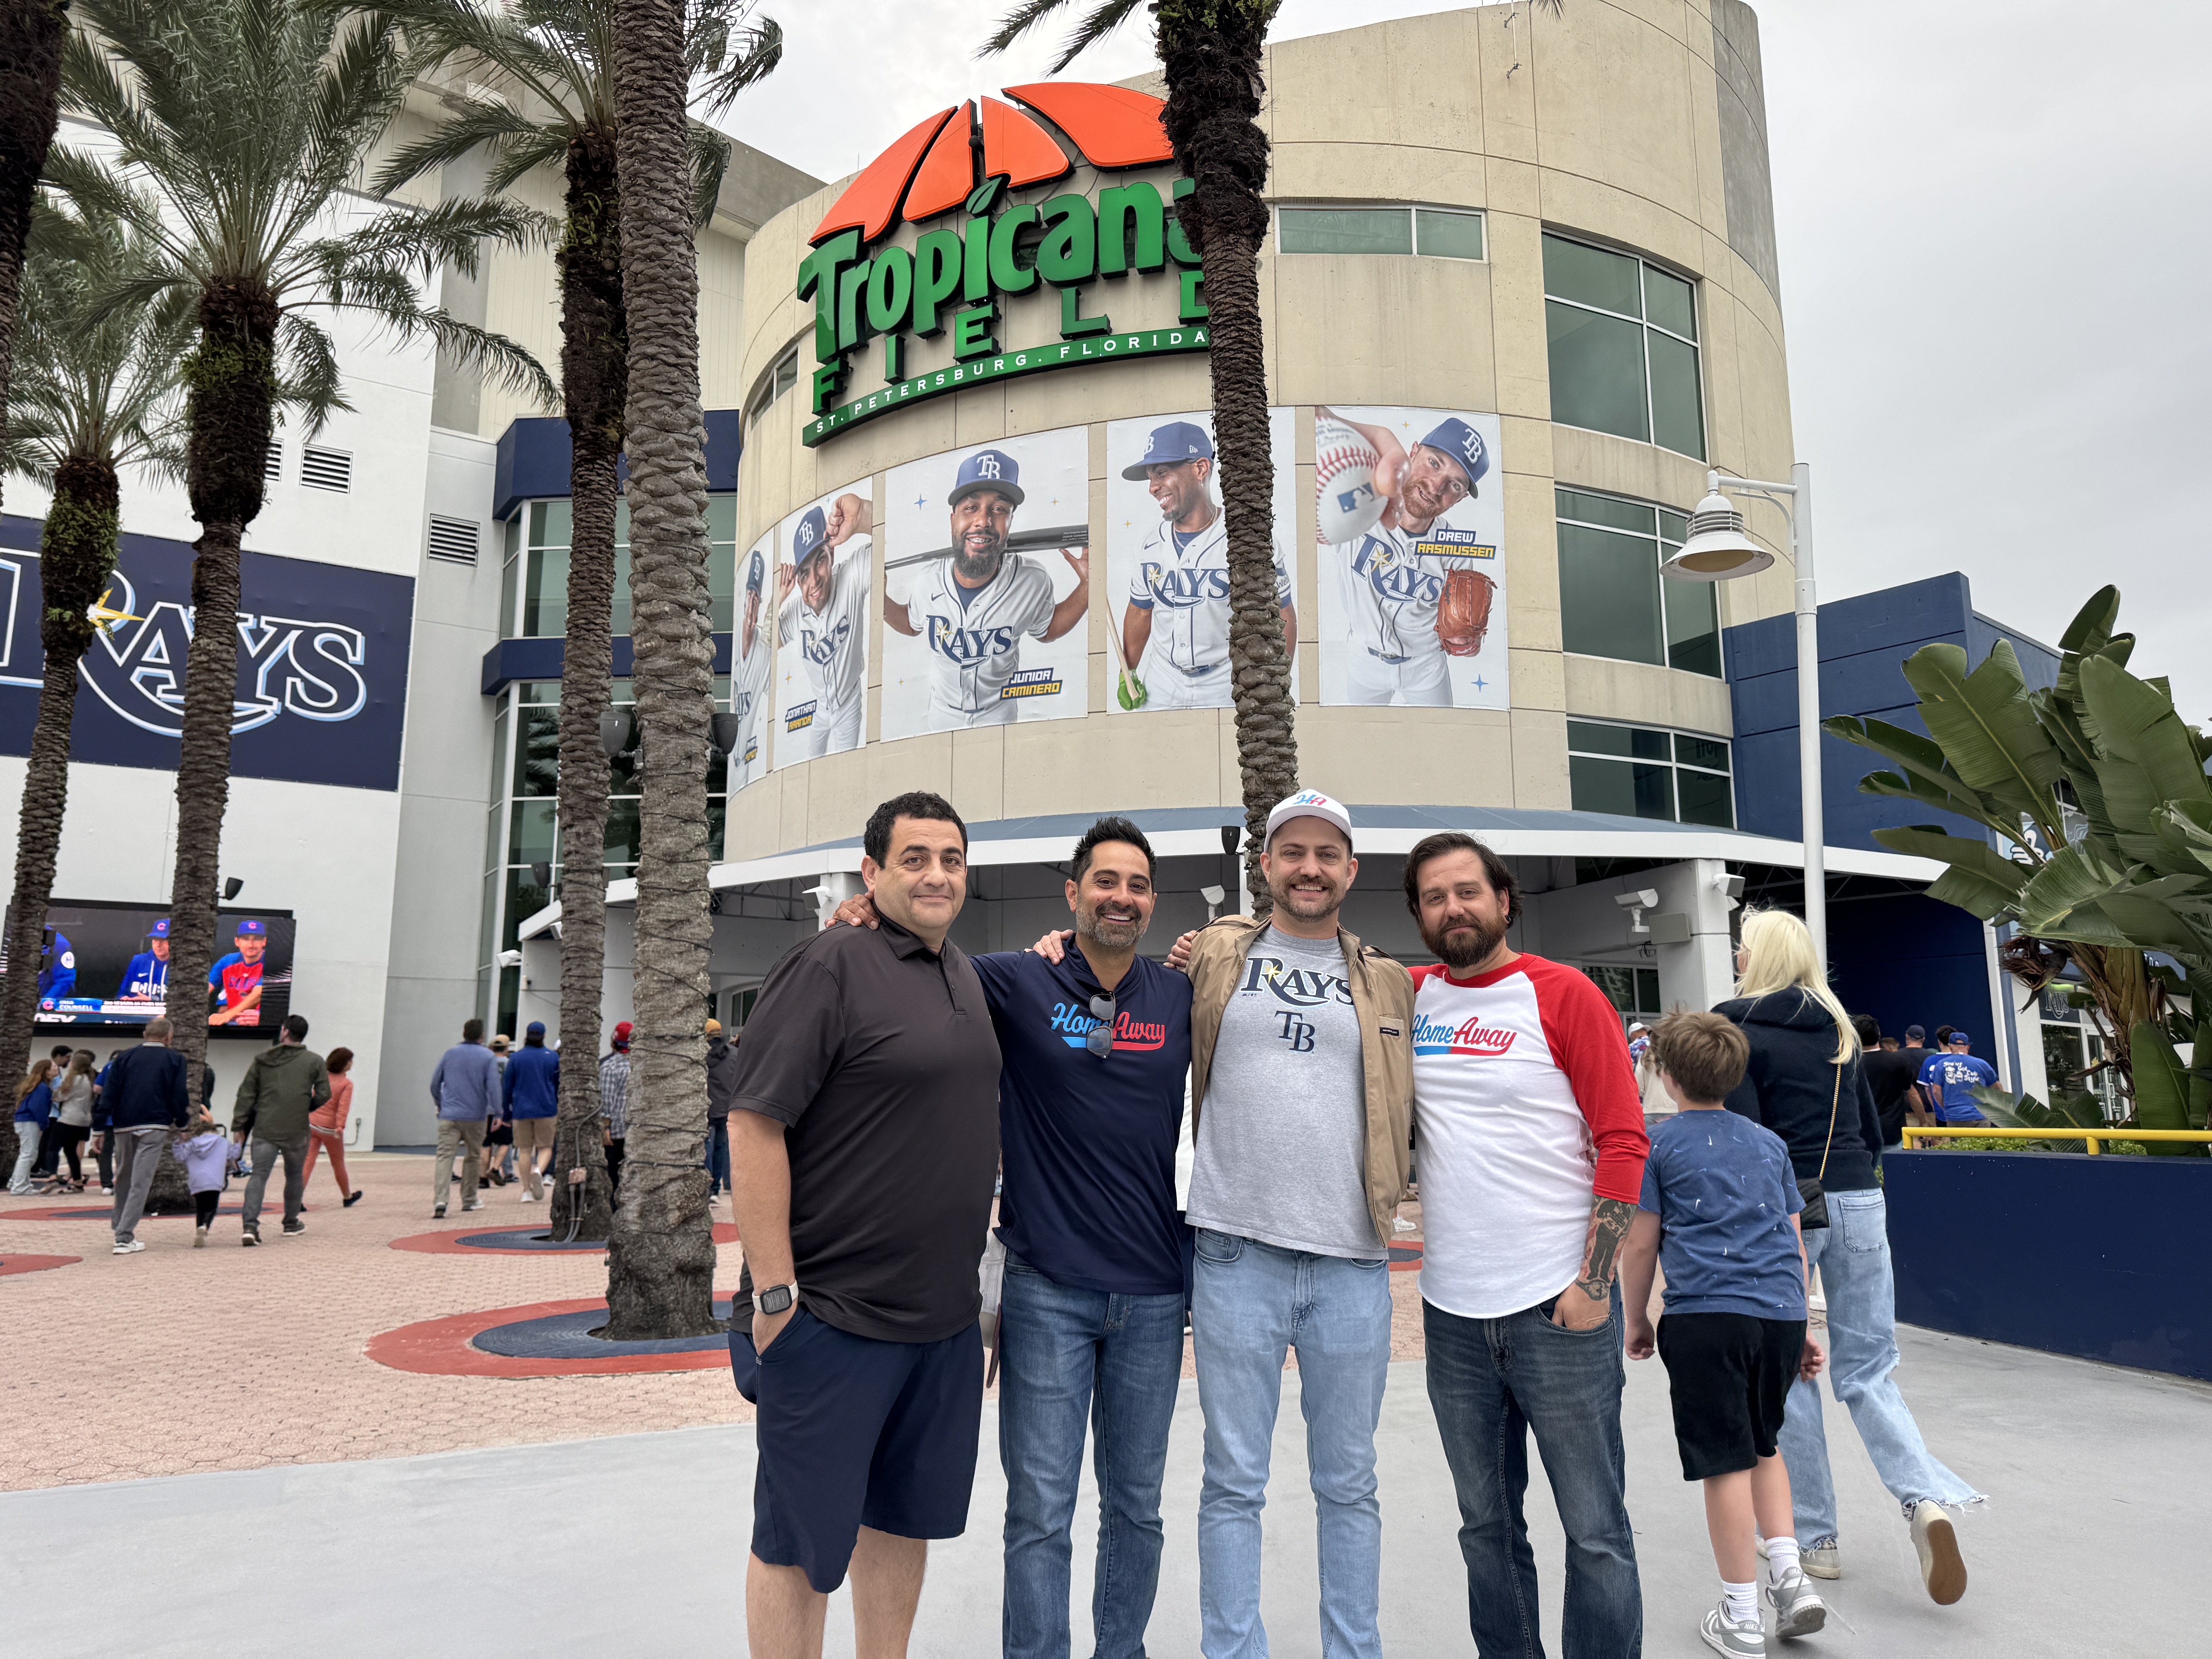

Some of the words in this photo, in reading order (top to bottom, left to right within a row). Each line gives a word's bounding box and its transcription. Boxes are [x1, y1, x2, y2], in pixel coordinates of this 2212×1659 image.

[816, 414, 843, 433] ST.
[1060, 331, 1206, 358] FLORIDA
[1462, 428, 1482, 464] TB
[976, 454, 1001, 479] TB
[799, 520, 814, 546] TB
[1437, 531, 1474, 543] DREW
[1417, 543, 1494, 558] RASMUSSEN
[1351, 533, 1444, 603] RAYS
[1140, 562, 1230, 610] RAYS
[800, 615, 850, 666] RAYS
[926, 614, 1014, 671] RAYS
[1002, 682, 1060, 698] CAMINERO
[1010, 670, 1051, 684] JUNIOR
[786, 701, 816, 720] JONATHAN
[788, 714, 812, 731] ARANDA
[1291, 794, 1327, 805] HA
[1239, 957, 1355, 1007] RAYS
[1274, 1010, 1315, 1053] TB
